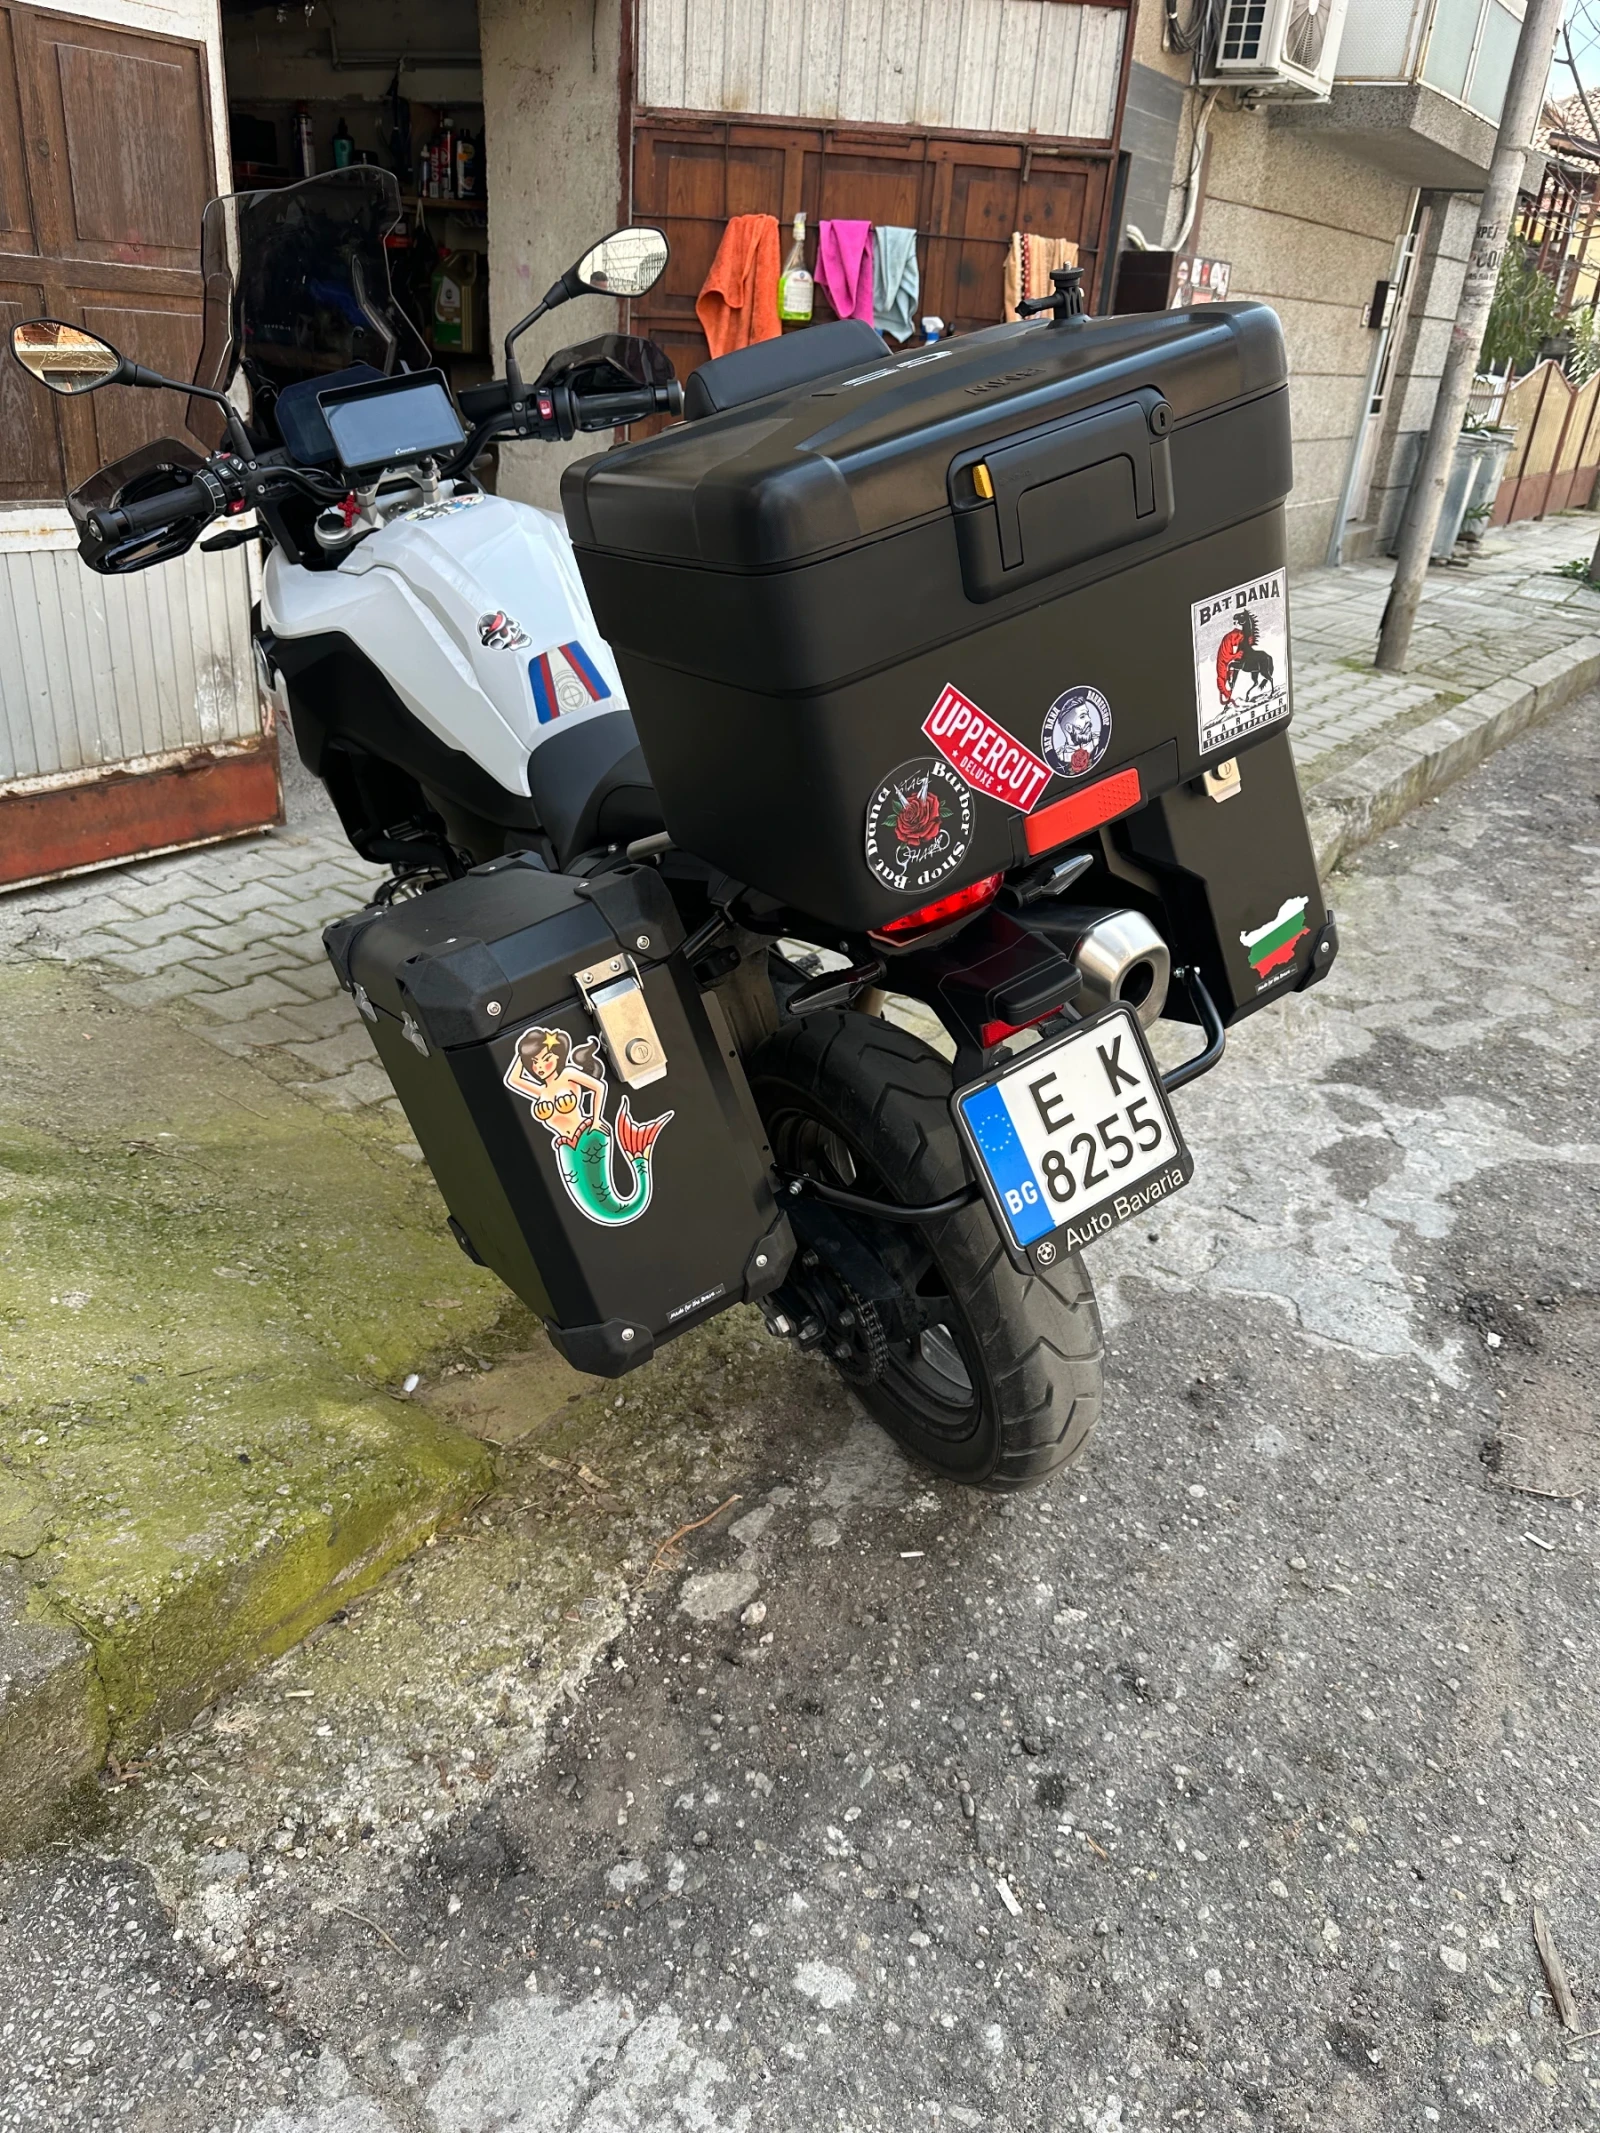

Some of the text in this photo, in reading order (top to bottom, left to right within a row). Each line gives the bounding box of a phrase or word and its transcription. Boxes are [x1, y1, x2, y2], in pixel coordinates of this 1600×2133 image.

[1199, 579, 1280, 626] BAT DANA
[931, 691, 1047, 806] UPPERCUT
[1045, 706, 1061, 731] DANA
[1206, 698, 1284, 739] BARBER
[958, 755, 995, 788] DELUXE
[867, 761, 972, 890] Barber Shop Bat Dana
[1029, 1034, 1140, 1135] E K
[1041, 1096, 1163, 1203] 8255
[1004, 1180, 1039, 1216] BG
[1065, 1168, 1185, 1251] Auto Bavaria
